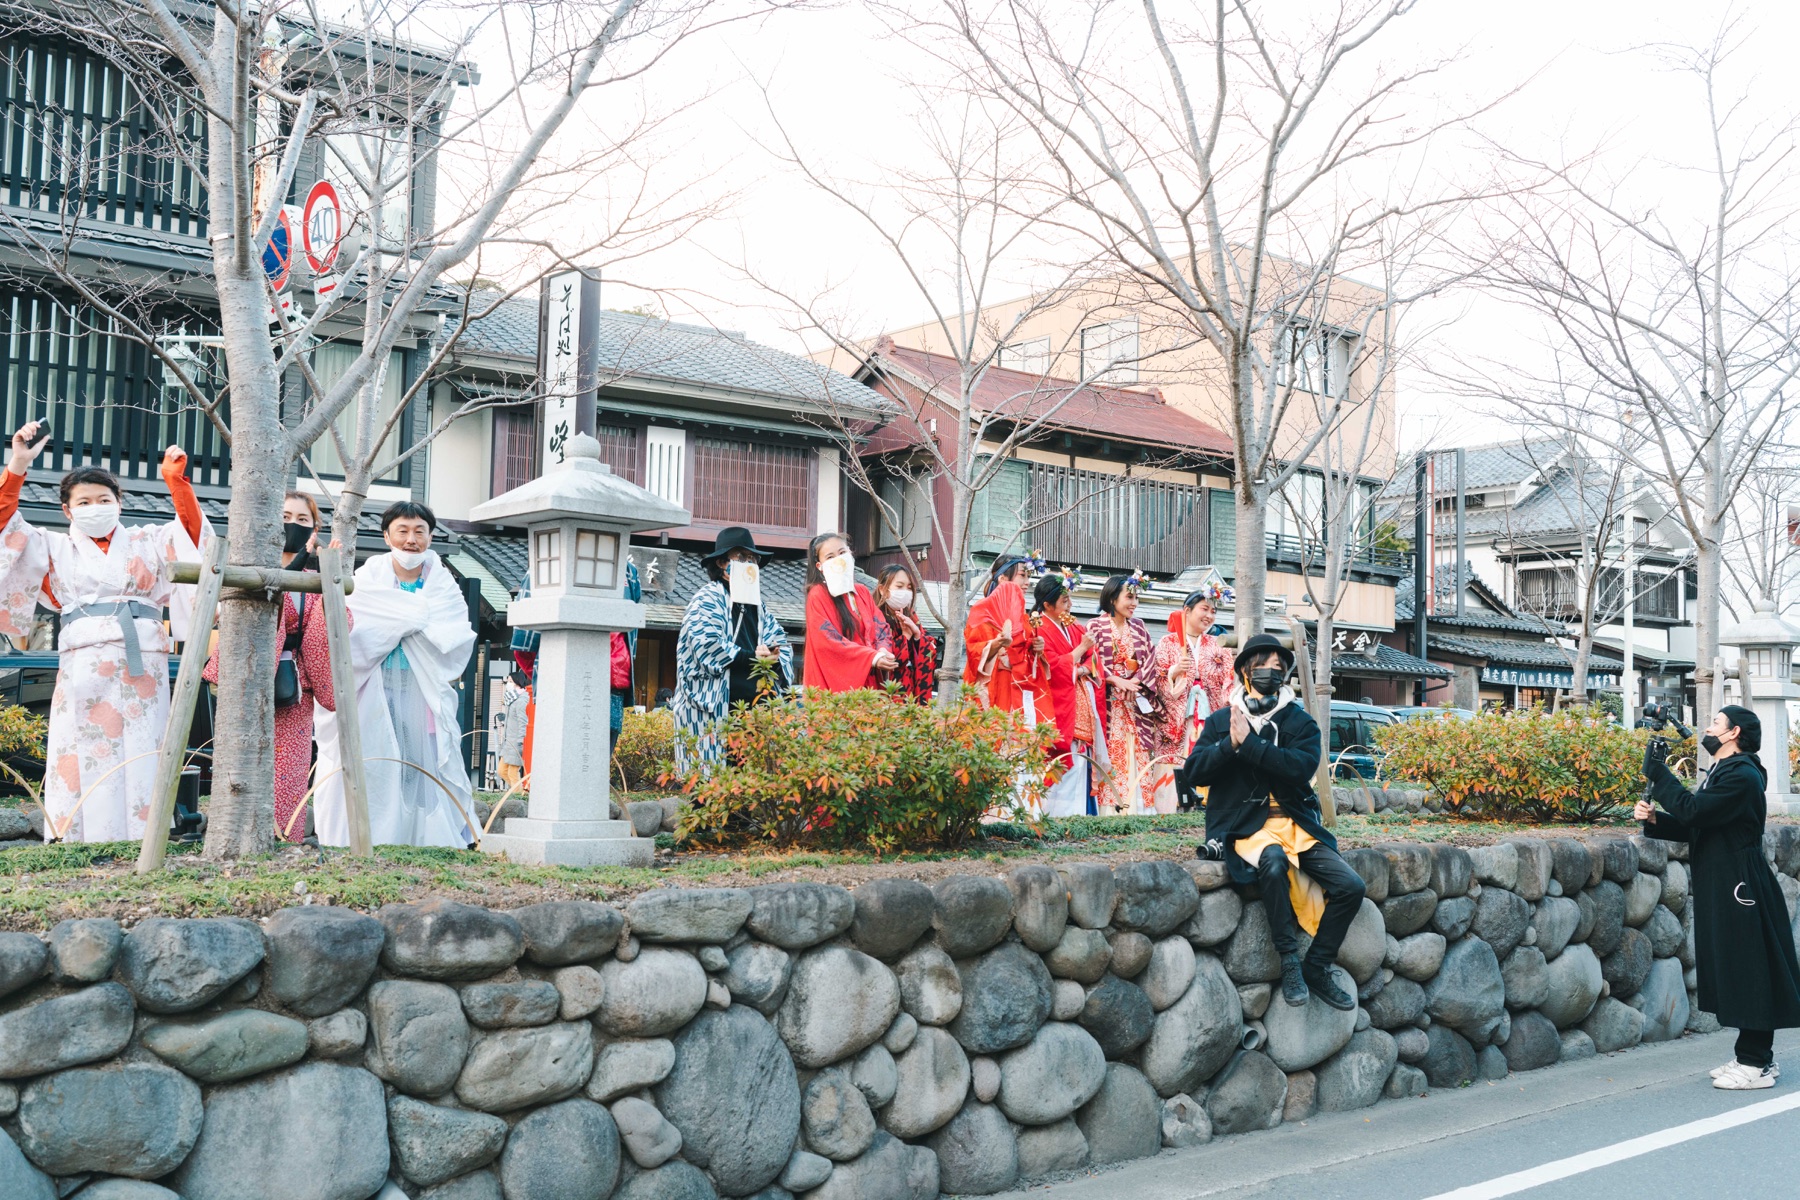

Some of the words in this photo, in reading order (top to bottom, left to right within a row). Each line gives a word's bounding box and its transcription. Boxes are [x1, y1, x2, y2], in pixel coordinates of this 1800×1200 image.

[311, 206, 334, 249] 40
[555, 283, 575, 357] そば処
